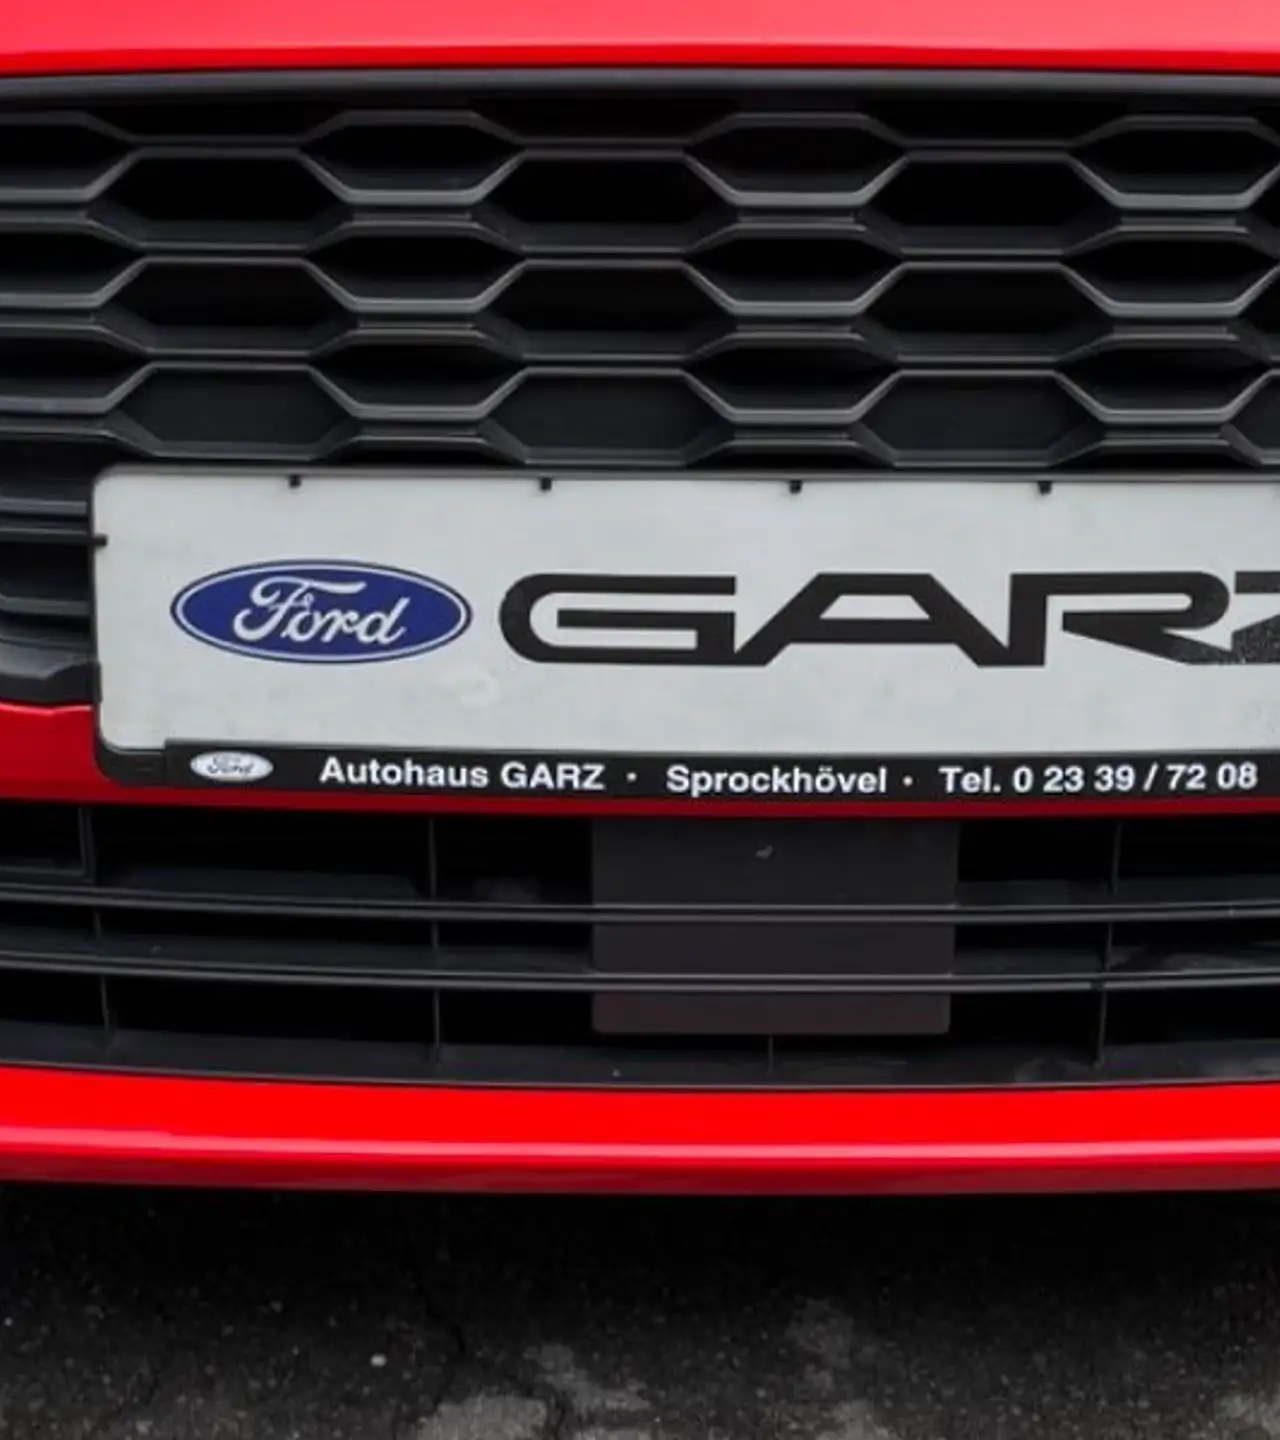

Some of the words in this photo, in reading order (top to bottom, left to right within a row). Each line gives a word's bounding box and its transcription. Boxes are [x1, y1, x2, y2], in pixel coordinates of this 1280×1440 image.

[231, 574, 410, 647] Ford
[319, 756, 489, 789] Autohaus
[500, 761, 605, 791] GARZ
[666, 764, 888, 799] Sprockhövel
[938, 766, 1002, 794] Tel.
[1012, 765, 1034, 793] 0
[1042, 765, 1086, 793] 23
[1094, 764, 1136, 793] 39
[1166, 762, 1208, 791] 72
[1216, 760, 1259, 790] 08
